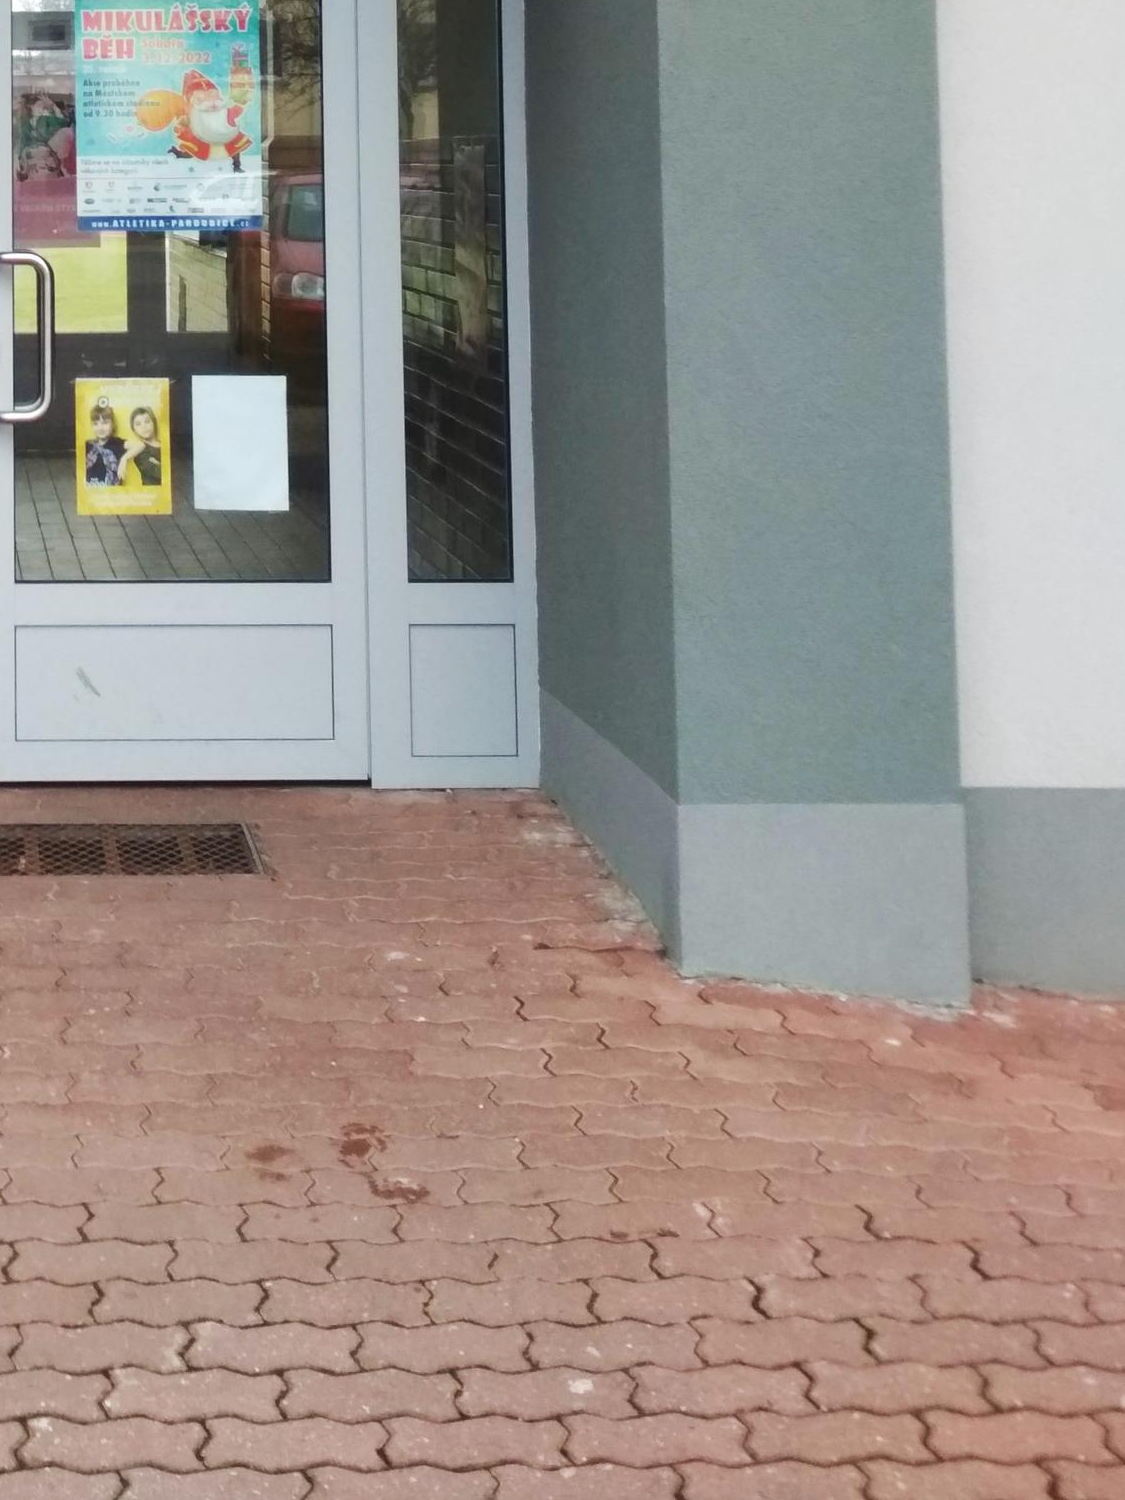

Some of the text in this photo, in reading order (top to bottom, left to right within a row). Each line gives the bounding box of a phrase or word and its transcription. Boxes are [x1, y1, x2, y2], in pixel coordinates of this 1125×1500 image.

[81, 3, 252, 32] MIKULÁŠSKÝ
[81, 35, 135, 60] BĚH
[178, 51, 212, 64] 2022
